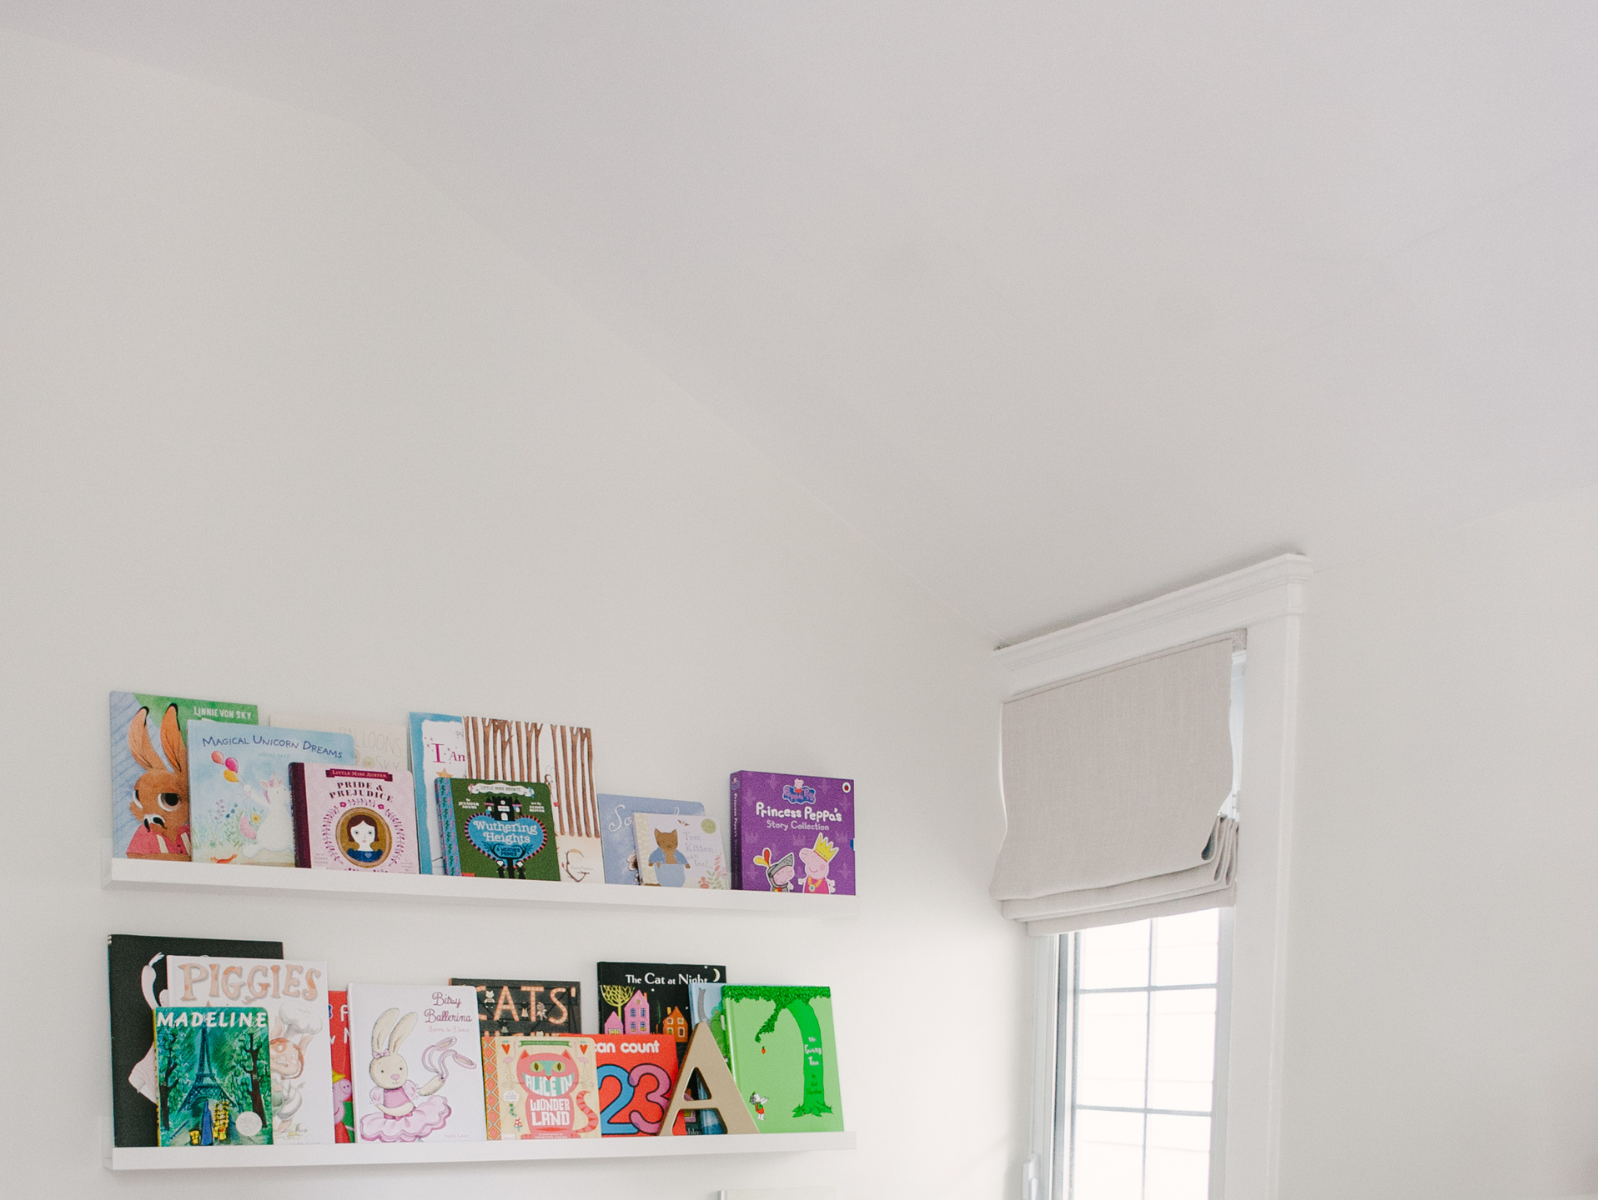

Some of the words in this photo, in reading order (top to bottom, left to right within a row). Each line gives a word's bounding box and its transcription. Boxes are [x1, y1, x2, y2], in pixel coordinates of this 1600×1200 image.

[193, 706, 218, 717] LINNIE
[219, 708, 234, 718] VON
[236, 710, 252, 719] SKY
[202, 735, 249, 748] MAGICAL
[252, 734, 300, 749] UNICORN
[302, 740, 343, 759] DREAMS
[431, 743, 446, 763] I
[336, 781, 373, 789] PRIDE
[376, 784, 384, 792] &
[329, 789, 394, 803] PREJUDICE
[755, 801, 802, 818] Princess
[804, 806, 843, 822] Peppa's
[473, 820, 538, 836] Wuthering
[766, 820, 789, 832] Story
[790, 820, 830, 832] Collection
[482, 832, 531, 845] Heights
[683, 831, 700, 841] Tom
[684, 843, 714, 853] Kitten
[178, 963, 322, 1005] PIGGIES
[625, 973, 642, 984] The
[644, 972, 666, 985] Cat
[667, 976, 676, 985] at
[678, 973, 708, 985] Night
[431, 991, 463, 1009] Bitsy
[156, 1011, 267, 1028] MADELINE
[423, 1008, 473, 1024] Ballerina
[620, 1040, 660, 1054] count
[525, 1075, 557, 1097] ALICE
[560, 1075, 574, 1096] IN
[657, 1021, 762, 1136] A
[529, 1098, 571, 1112] WONDER
[531, 1112, 571, 1127] LAND
